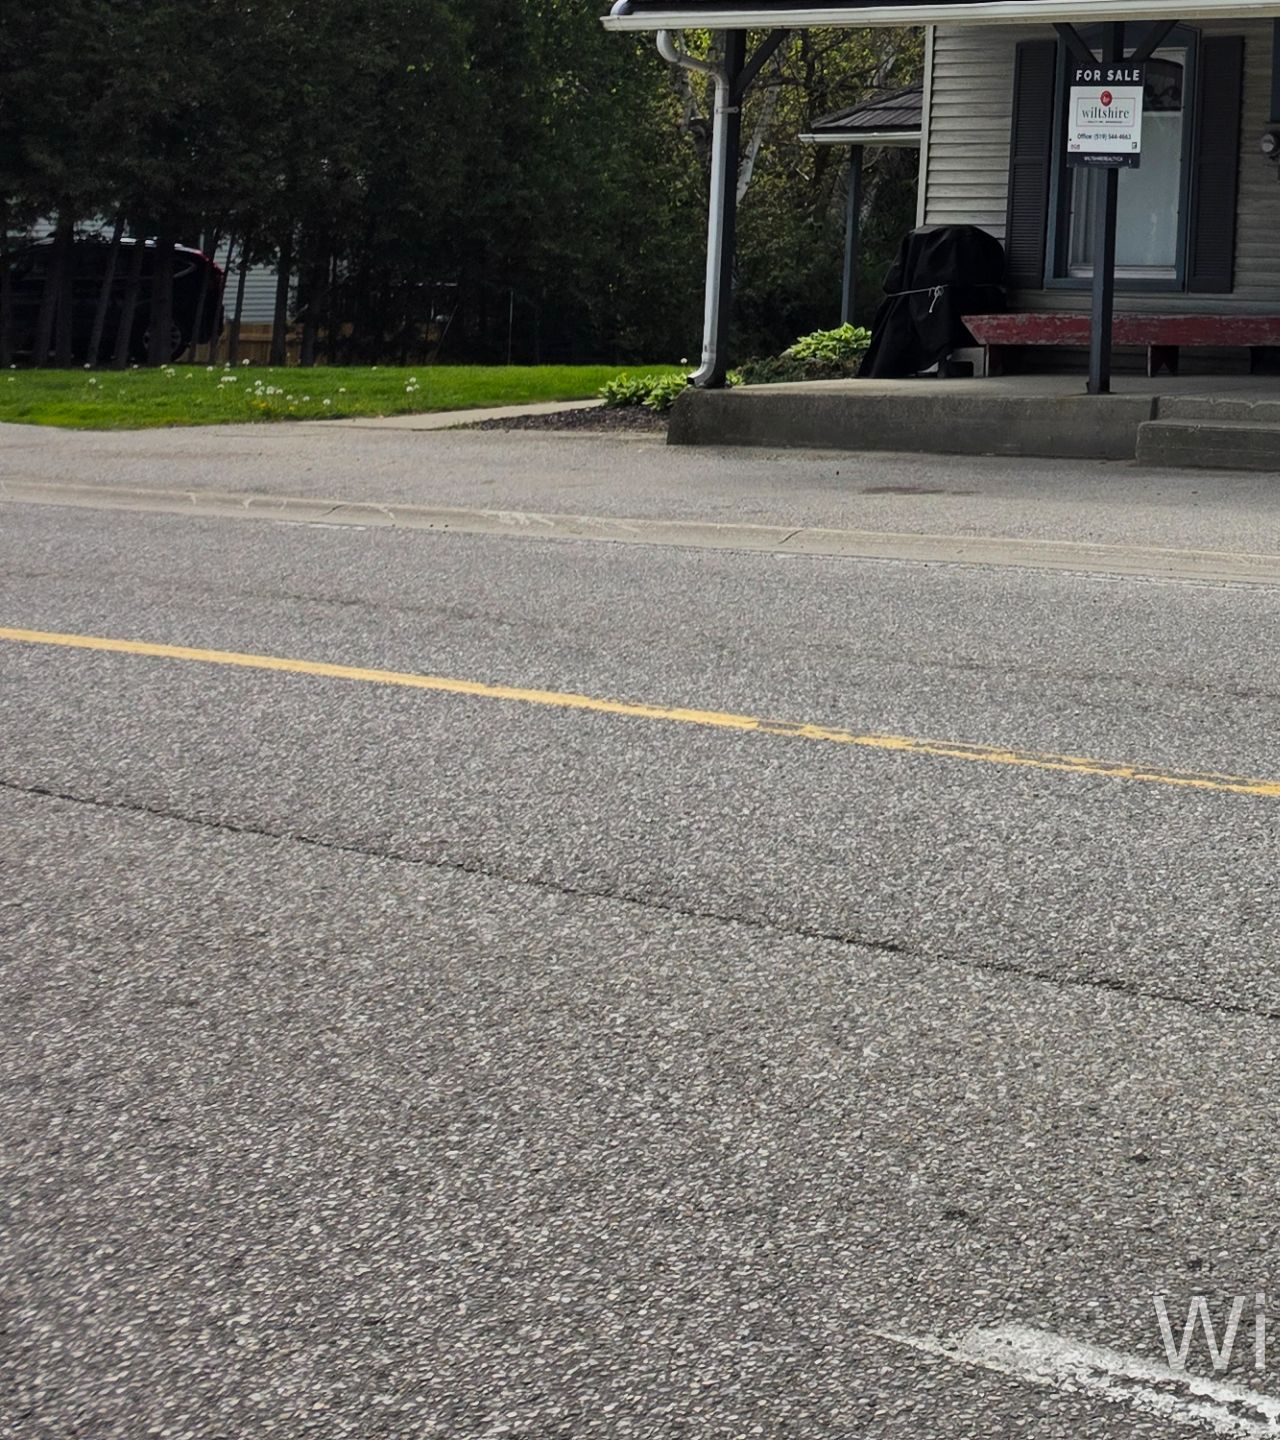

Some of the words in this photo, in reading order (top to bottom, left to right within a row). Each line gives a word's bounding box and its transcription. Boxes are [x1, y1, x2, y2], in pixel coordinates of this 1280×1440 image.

[1075, 69, 1101, 82] FOR
[1106, 69, 1141, 82] SALE
[1081, 106, 1130, 120] wiltshire
